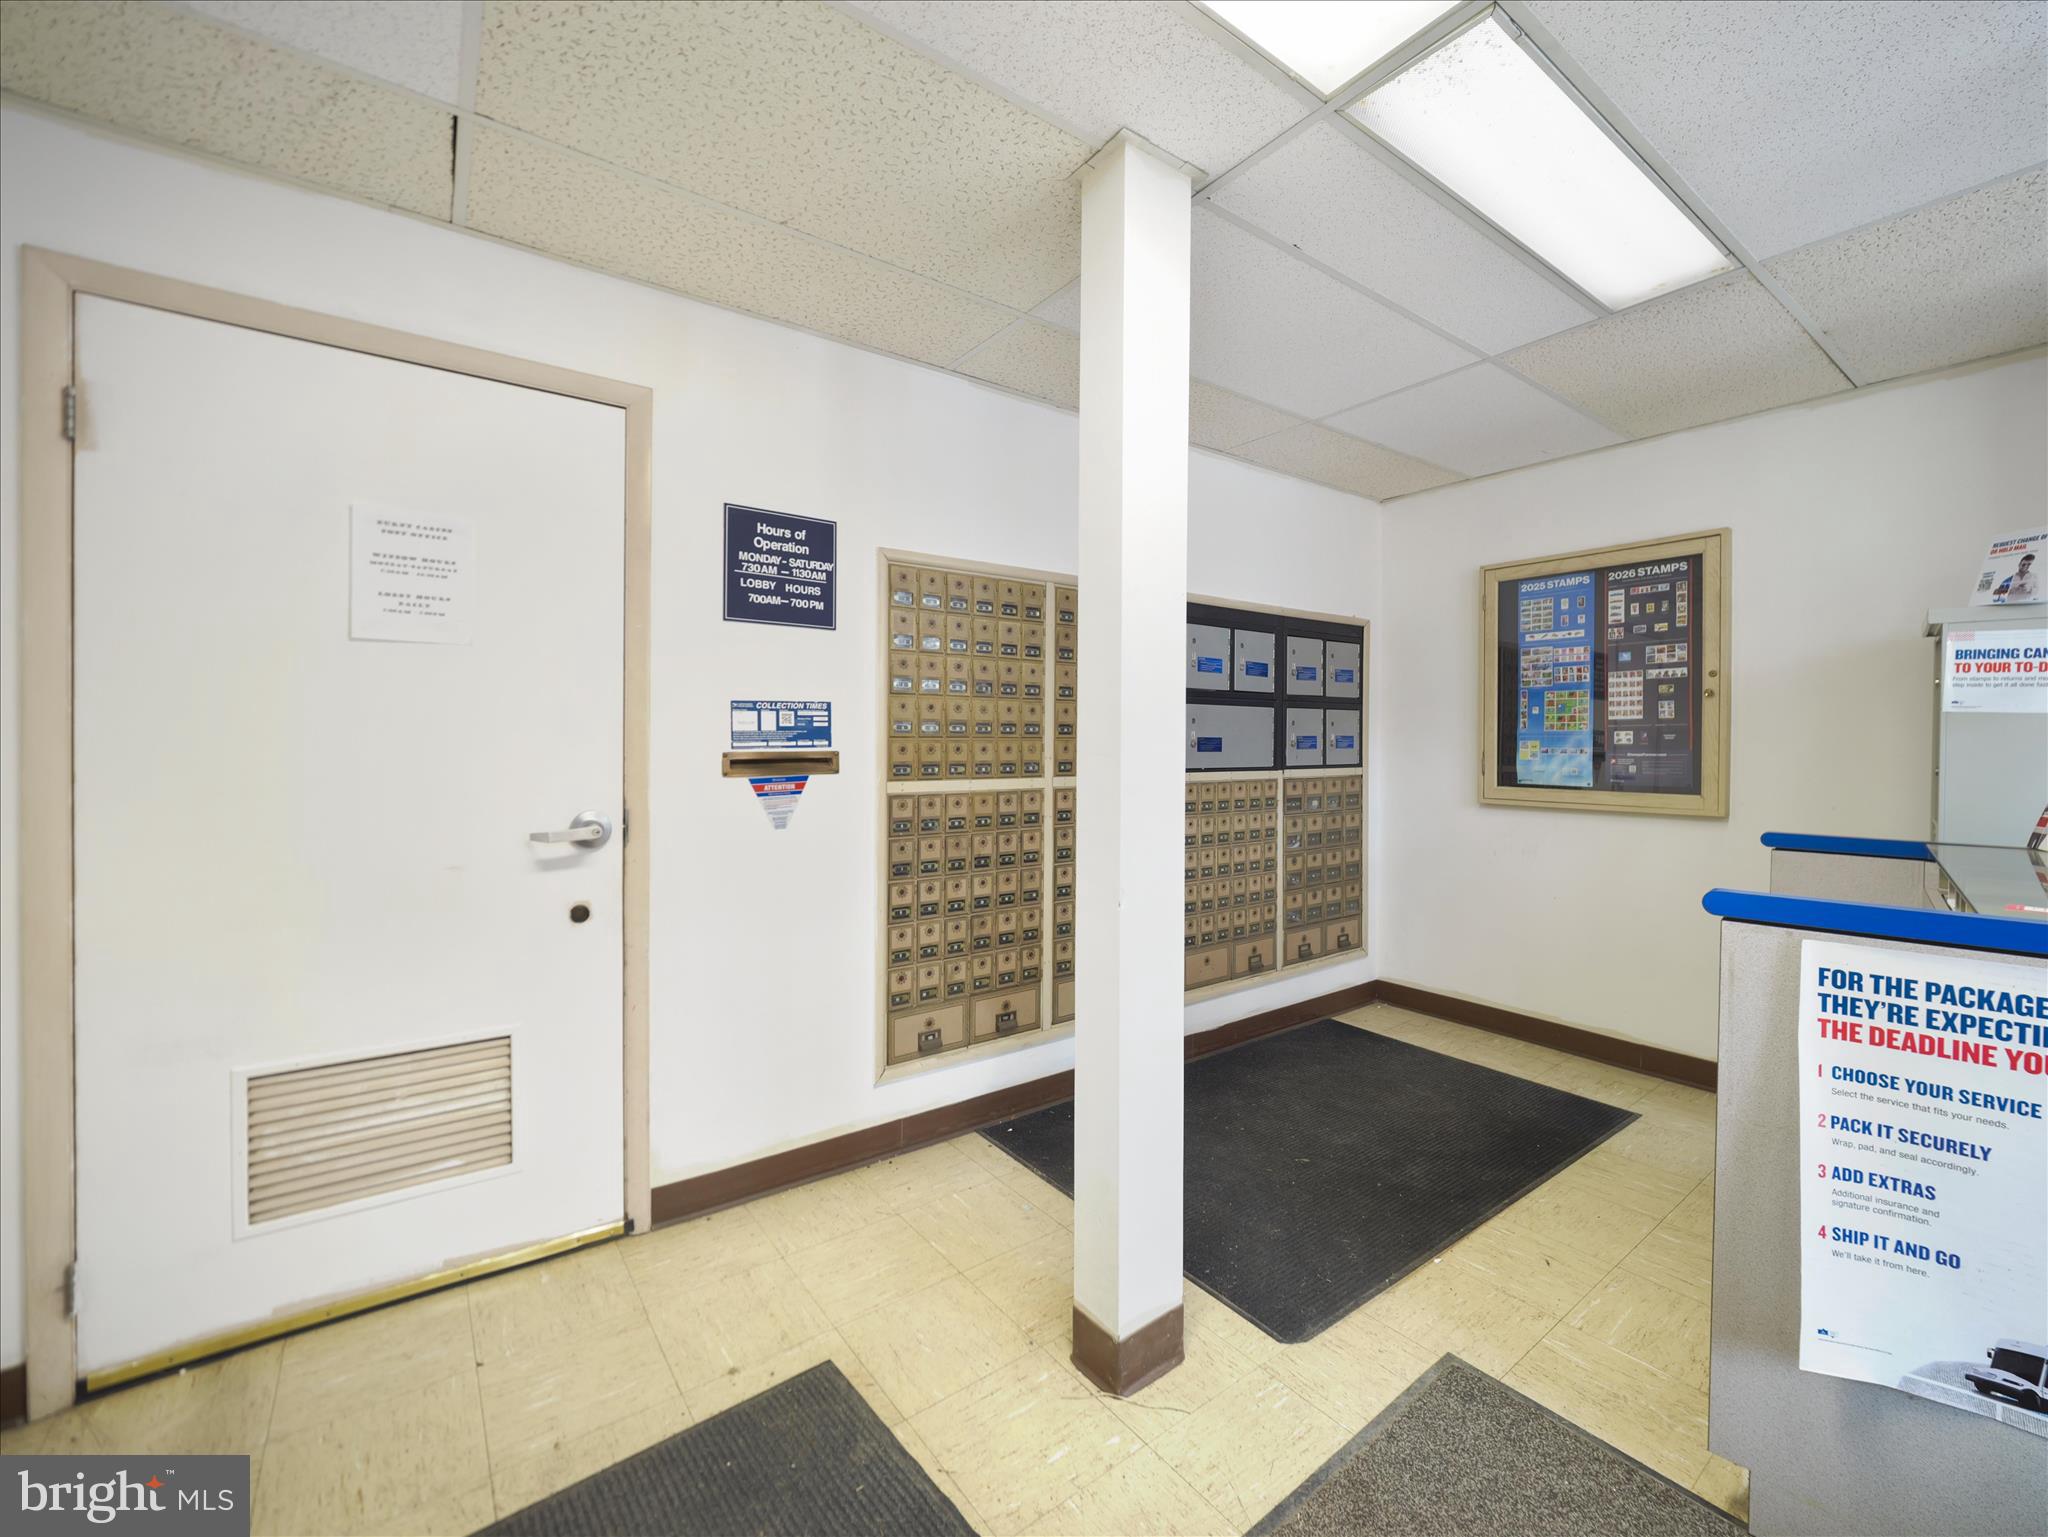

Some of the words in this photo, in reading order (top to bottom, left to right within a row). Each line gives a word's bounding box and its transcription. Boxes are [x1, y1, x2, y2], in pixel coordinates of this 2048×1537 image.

[754, 537, 809, 555] Operation
[757, 523, 791, 538] Hours
[795, 530, 806, 540] of
[738, 551, 781, 565] MONDAY
[788, 558, 834, 571] SATURDAY
[1608, 571, 1636, 580] 2026
[1638, 561, 1688, 576] STAMPS
[740, 578, 776, 590] LOBBY
[785, 584, 821, 595] HOURS
[1521, 583, 1545, 592] 2025
[1547, 576, 1590, 589] STAMPS
[1955, 648, 2020, 659] BRINGING
[1955, 662, 1971, 673] TO
[1975, 662, 2011, 673] YOUR
[1818, 967, 1863, 992] FOR
[1870, 974, 1918, 1000] THE
[1925, 982, 2048, 1019] PACKAGE
[1818, 993, 1919, 1027] THEY'RE
[1926, 1009, 2048, 1048] EXPECTI
[1817, 1018, 1862, 1043] THE
[1869, 1026, 1998, 1067] DEADLINE
[2005, 1048, 2048, 1077] YO
[1818, 1064, 1822, 1077] 1
[1832, 1066, 1900, 1091] CHOOSE
[1905, 1078, 1954, 1102] YOUR
[1959, 1090, 2042, 1120] SERVICE
[1832, 1088, 1858, 1099] Select
[1860, 1093, 1874, 1102] the
[1877, 1095, 1909, 1109] service
[1912, 1103, 1931, 1113] that
[1934, 1107, 1949, 1117] fits
[1951, 1112, 1973, 1123] your
[1976, 1116, 2009, 1130] needs.
[1818, 1114, 1826, 1127] 2
[1830, 1115, 1872, 1136] PACK
[1877, 1124, 1893, 1139] IT
[1898, 1128, 1992, 1162] SECURELY
[1832, 1137, 1855, 1149] Wrap,
[1858, 1143, 1877, 1154] pad,
[1879, 1146, 1896, 1157] and
[1899, 1150, 1918, 1161] seal
[1921, 1157, 1979, 1176] accordingly.
[1818, 1164, 1826, 1178] 3
[1832, 1166, 1863, 1184] ADD
[1869, 1172, 1936, 1200] EXTRAS
[1832, 1188, 1872, 1202] Additional
[1875, 1197, 1919, 1213] insurance
[1922, 1208, 1940, 1218] and
[1832, 1199, 1870, 1212] signature
[1873, 1207, 1932, 1226] confirmation.
[1818, 1225, 1826, 1239] 4
[1832, 1227, 1869, 1246] SHIP
[1874, 1235, 1890, 1251] IT
[1894, 1240, 1930, 1260] AND
[1936, 1250, 1961, 1269] GO
[1832, 1249, 1851, 1258] We'll
[1854, 1253, 1872, 1264] take
[1874, 1257, 1880, 1265] it
[1883, 1260, 1903, 1271] from
[1906, 1265, 1930, 1278] here.
